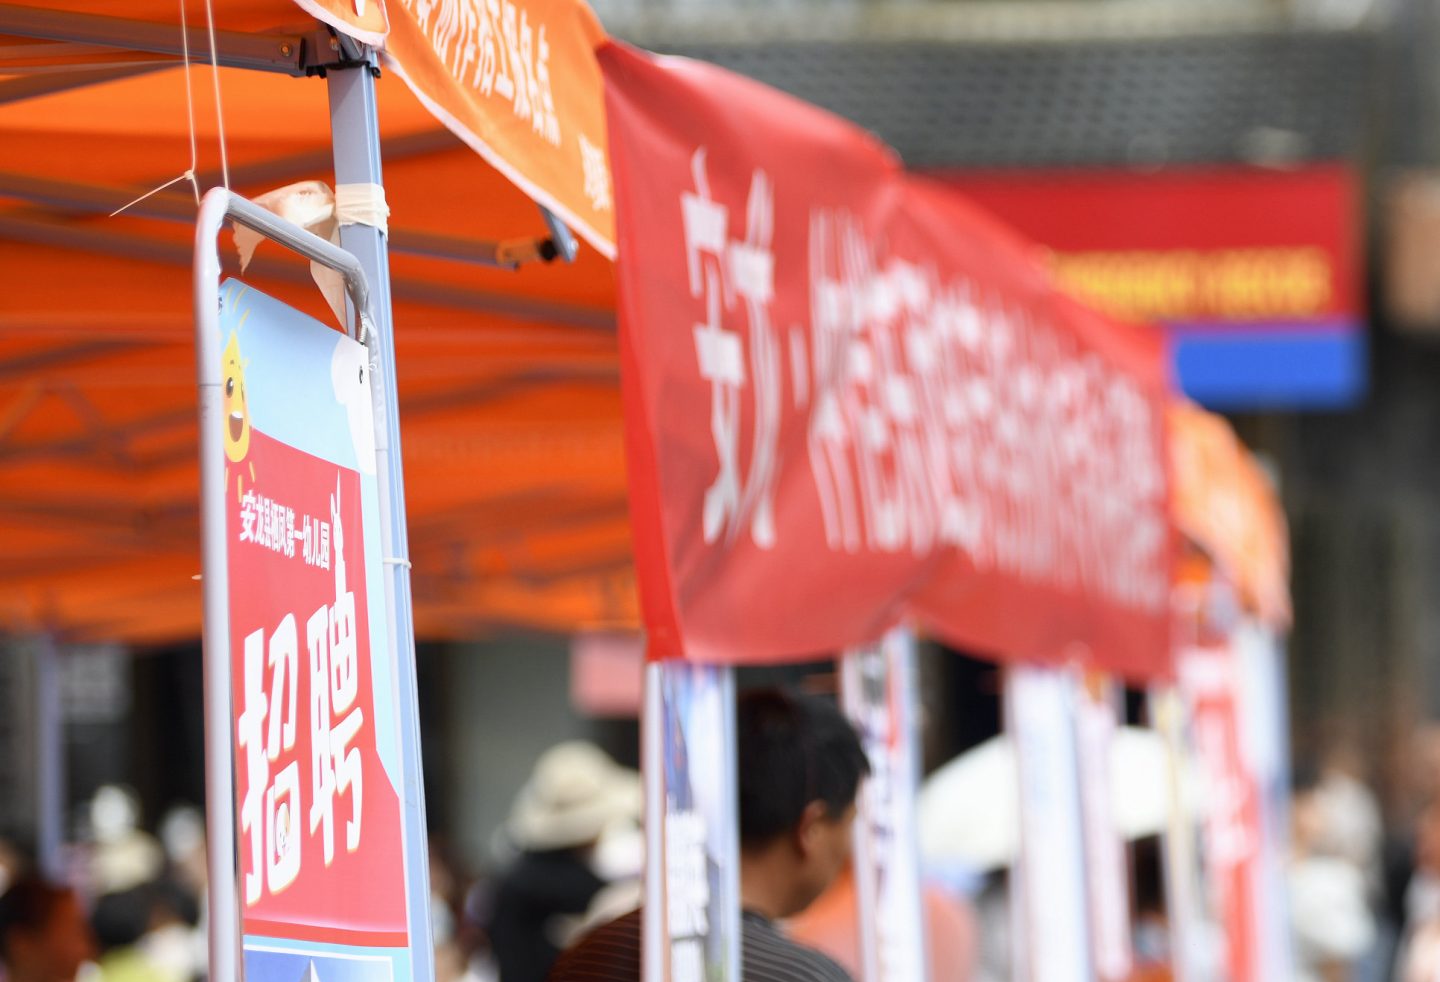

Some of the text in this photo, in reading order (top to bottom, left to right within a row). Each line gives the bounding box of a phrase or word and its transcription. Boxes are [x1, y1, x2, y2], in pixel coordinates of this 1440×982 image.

[239, 489, 331, 571] 安龙县栖凤第一幼儿园
[238, 592, 364, 906] 招聘
